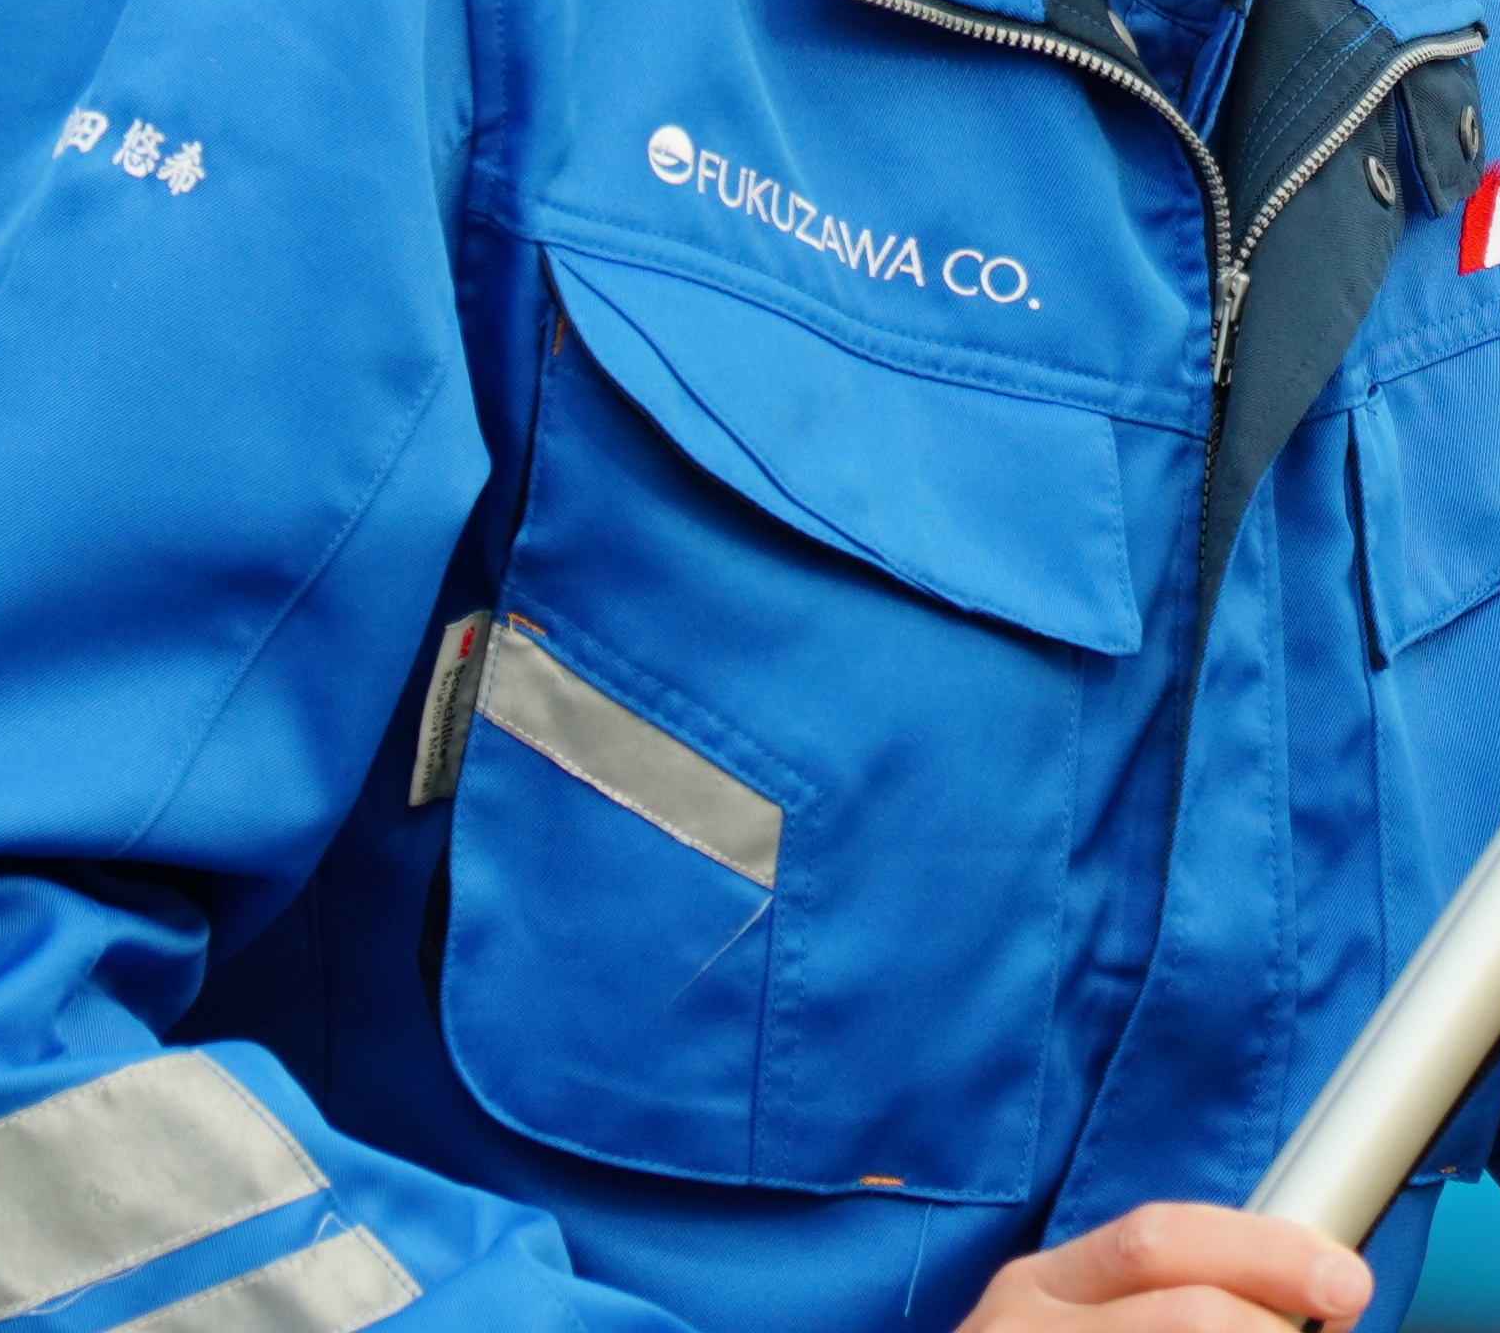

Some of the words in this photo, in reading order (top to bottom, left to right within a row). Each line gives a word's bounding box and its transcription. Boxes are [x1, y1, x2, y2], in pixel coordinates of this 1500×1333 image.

[696, 149, 926, 288] FUKUZAWA
[941, 249, 1042, 311] CO.
[457, 625, 476, 660] 3M
